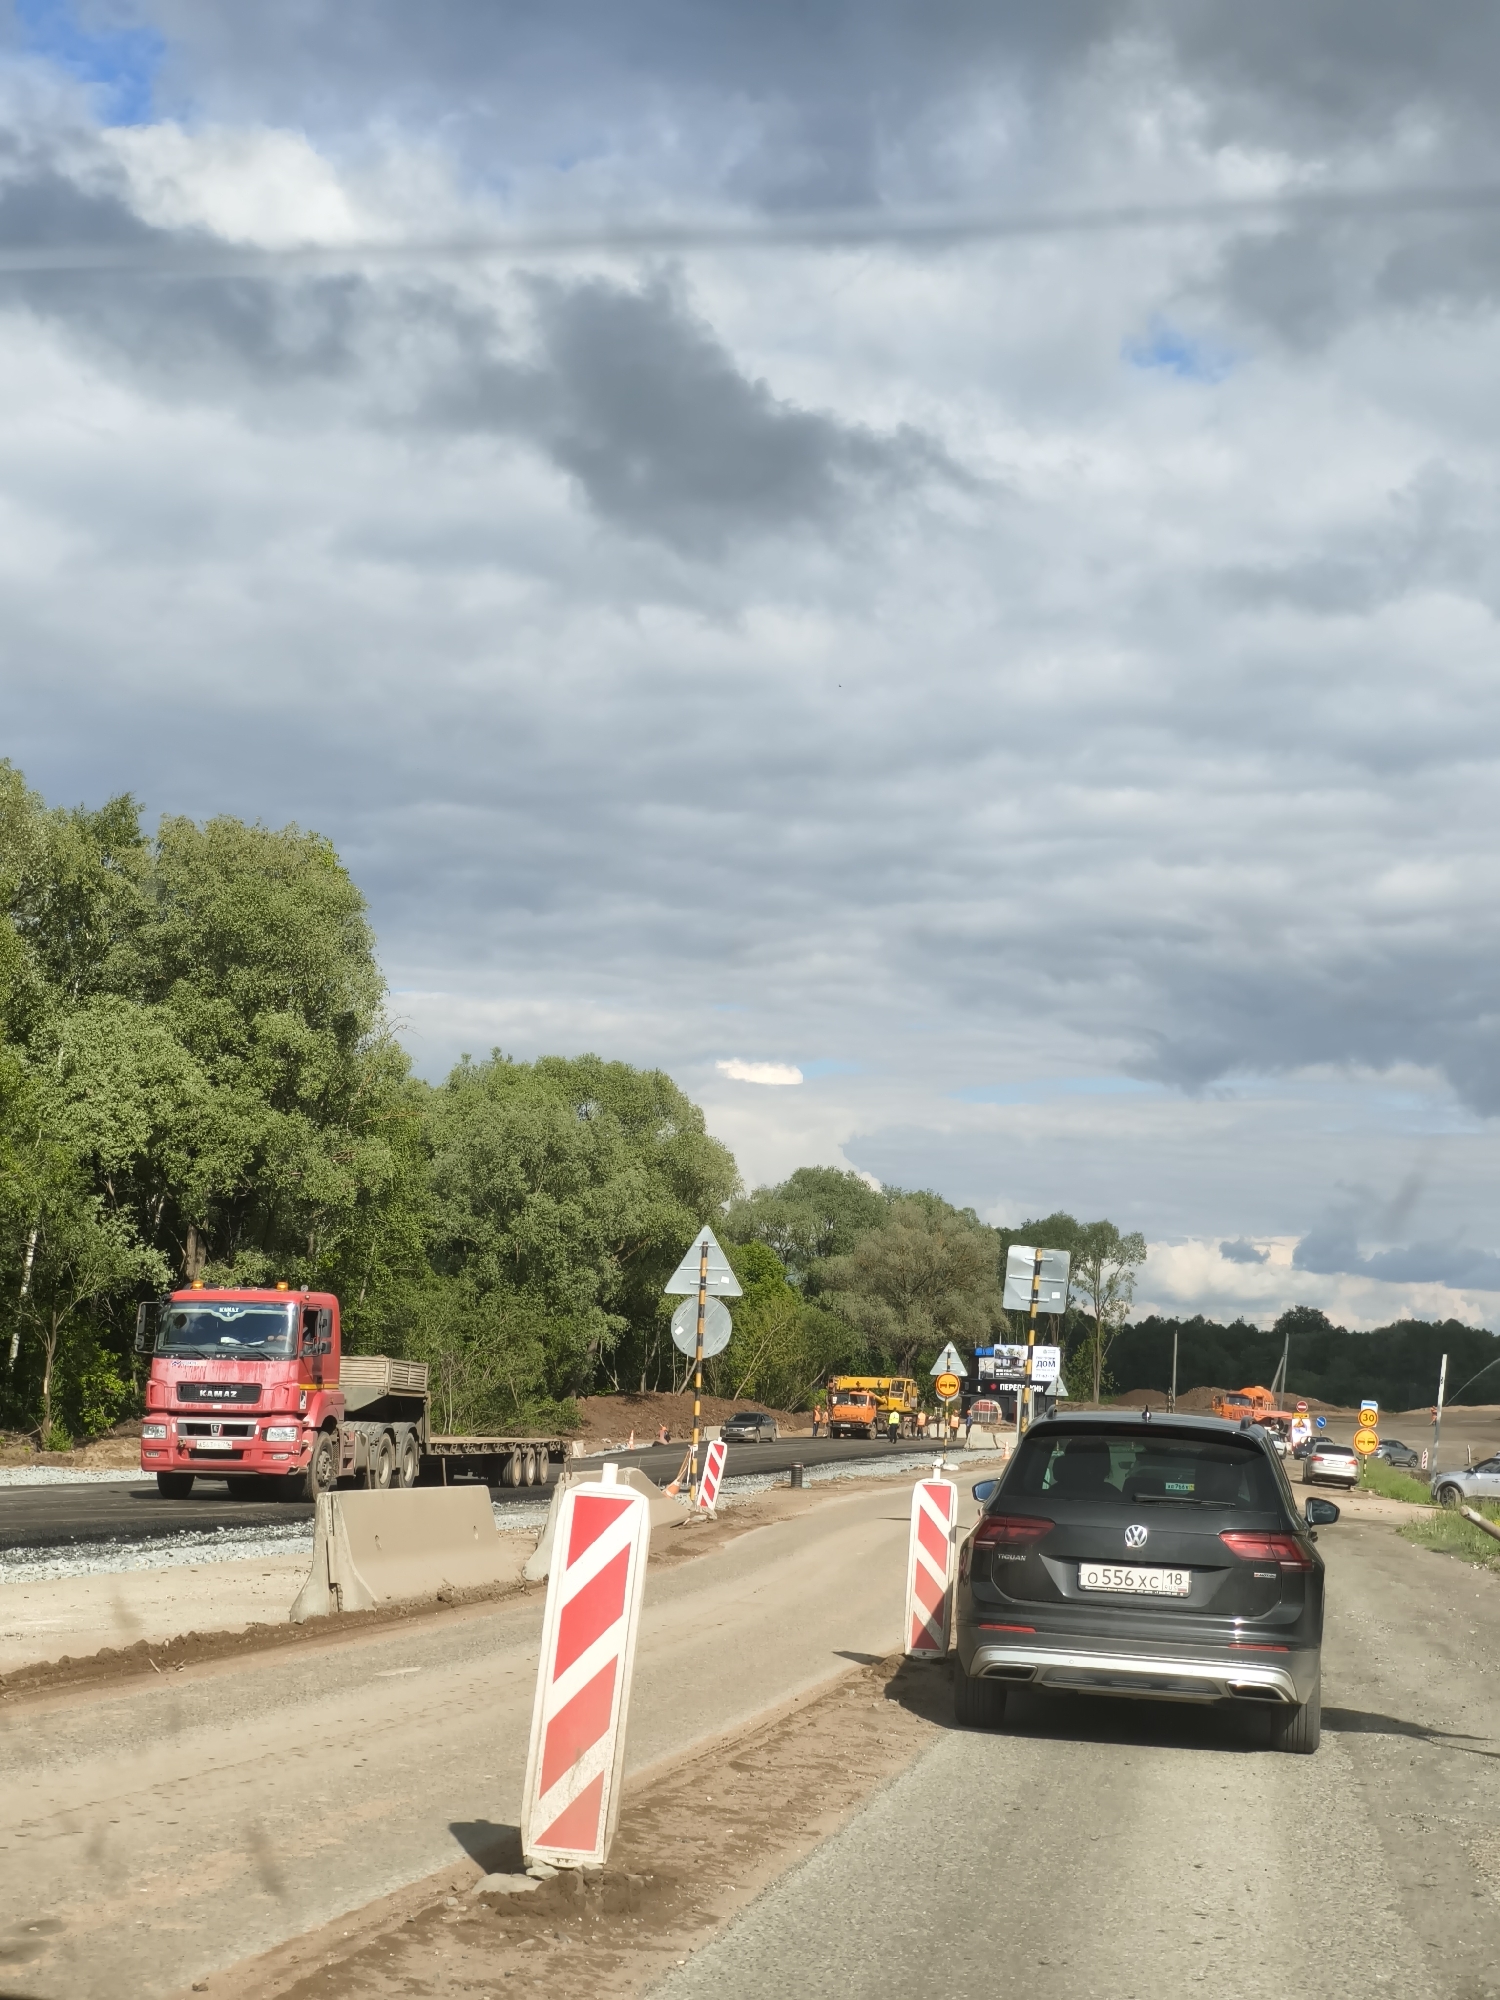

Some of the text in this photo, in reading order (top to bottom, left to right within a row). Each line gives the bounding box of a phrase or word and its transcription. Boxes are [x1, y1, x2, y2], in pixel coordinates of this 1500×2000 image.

[1036, 1360, 1056, 1368] ДОМ
[200, 1389, 237, 1398] KAMAZ
[1362, 1413, 1375, 1422] 30
[1167, 1573, 1183, 1585] 18
